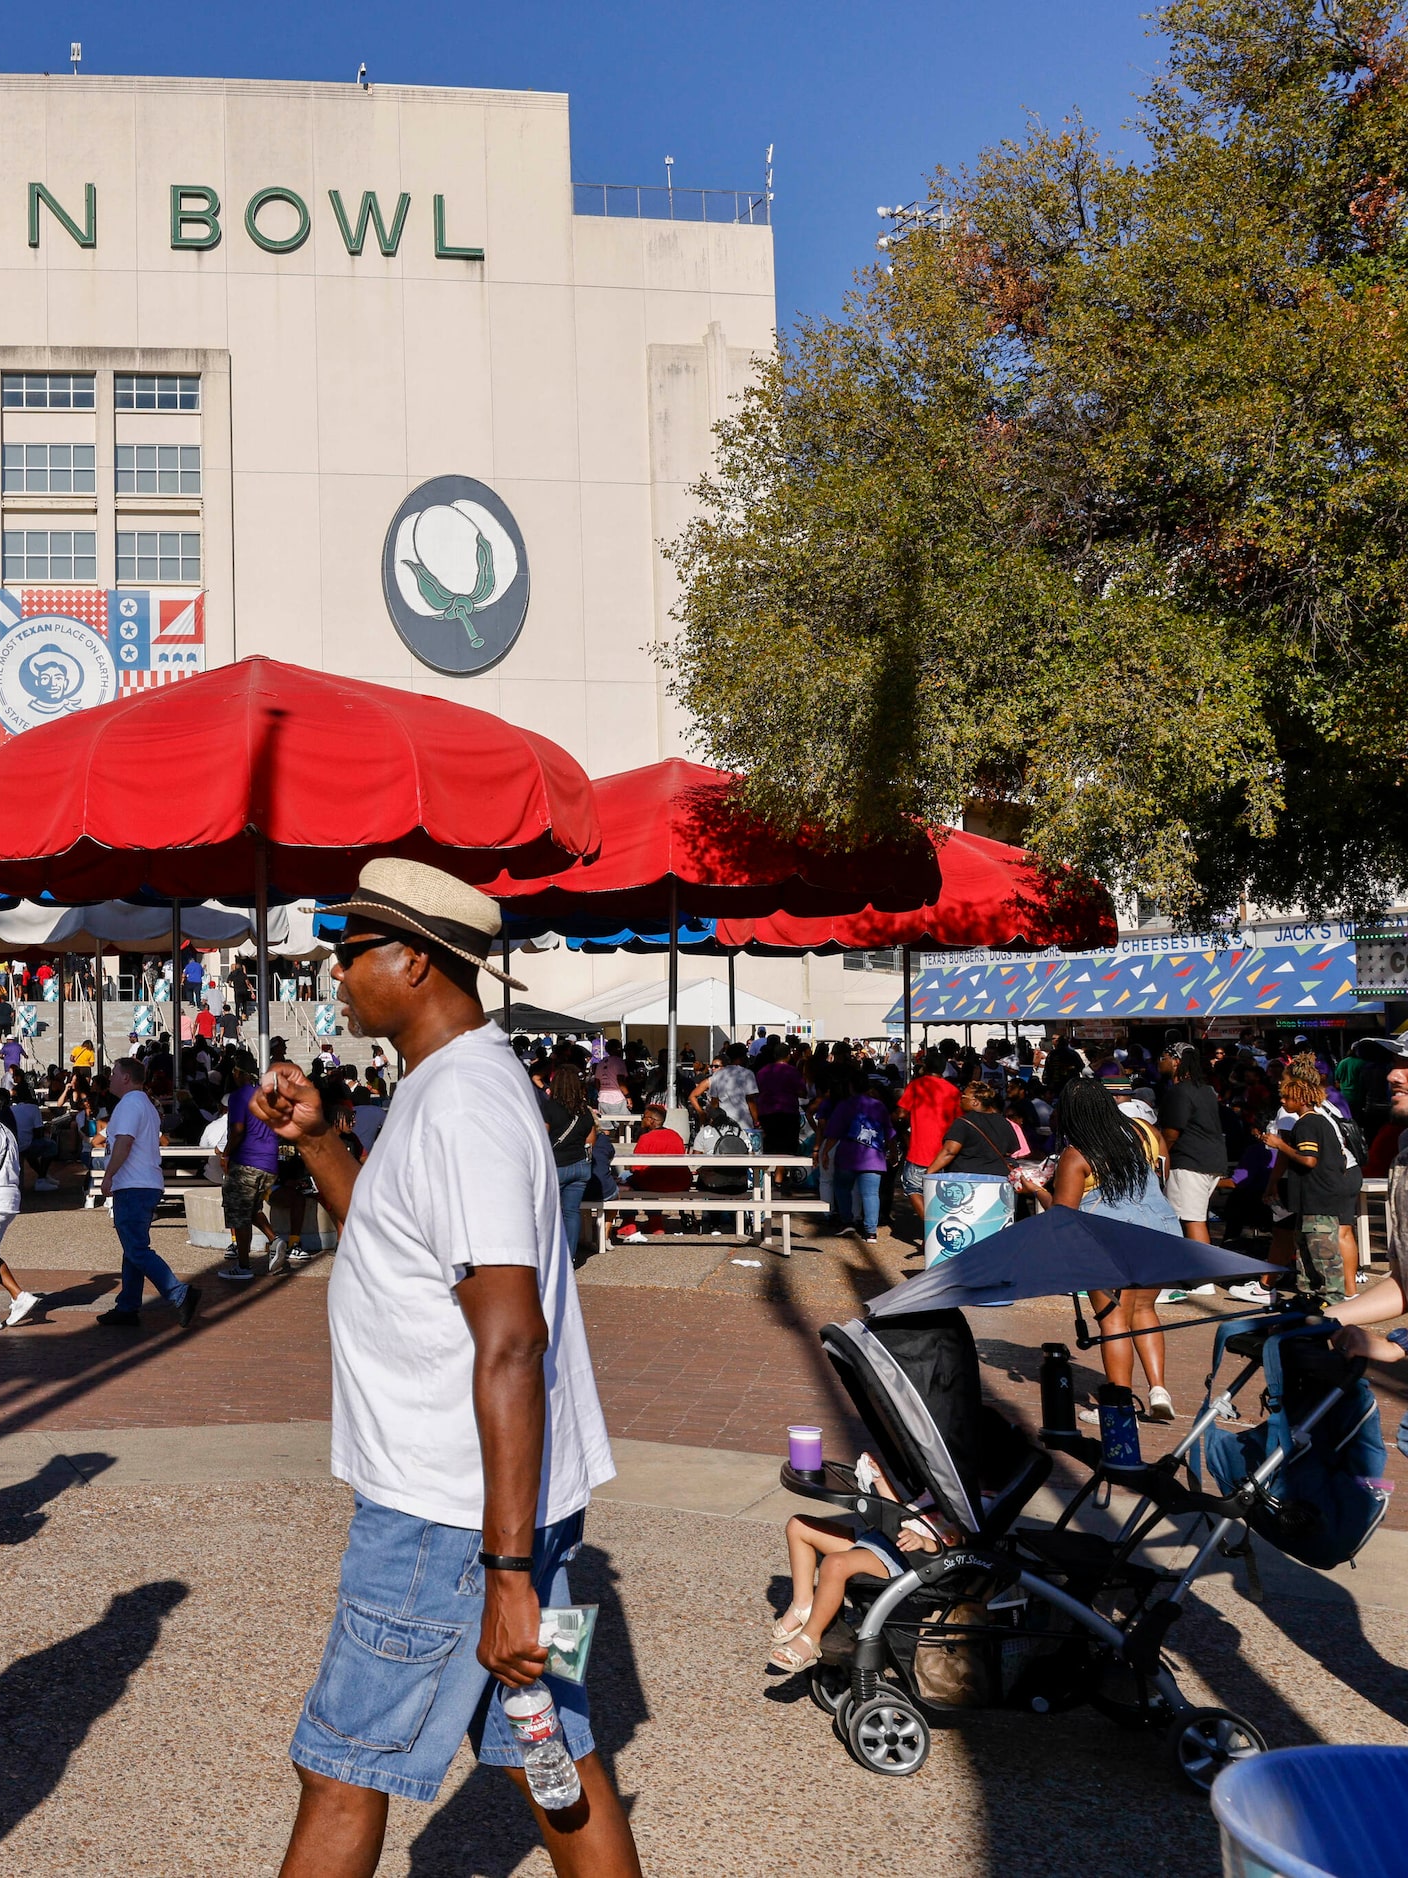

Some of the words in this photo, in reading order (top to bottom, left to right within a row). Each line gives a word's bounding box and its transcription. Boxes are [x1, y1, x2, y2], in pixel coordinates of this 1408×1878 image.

[170, 185, 484, 260] BOWL
[0, 639, 17, 666] MOST
[15, 624, 52, 641] TEXAN
[54, 624, 86, 641] PLACE
[85, 640, 99, 654] ON
[95, 655, 109, 687] EARTH
[4, 707, 30, 730] STATE
[1275, 923, 1331, 942] JACK'S
[924, 952, 946, 966] TEXAS
